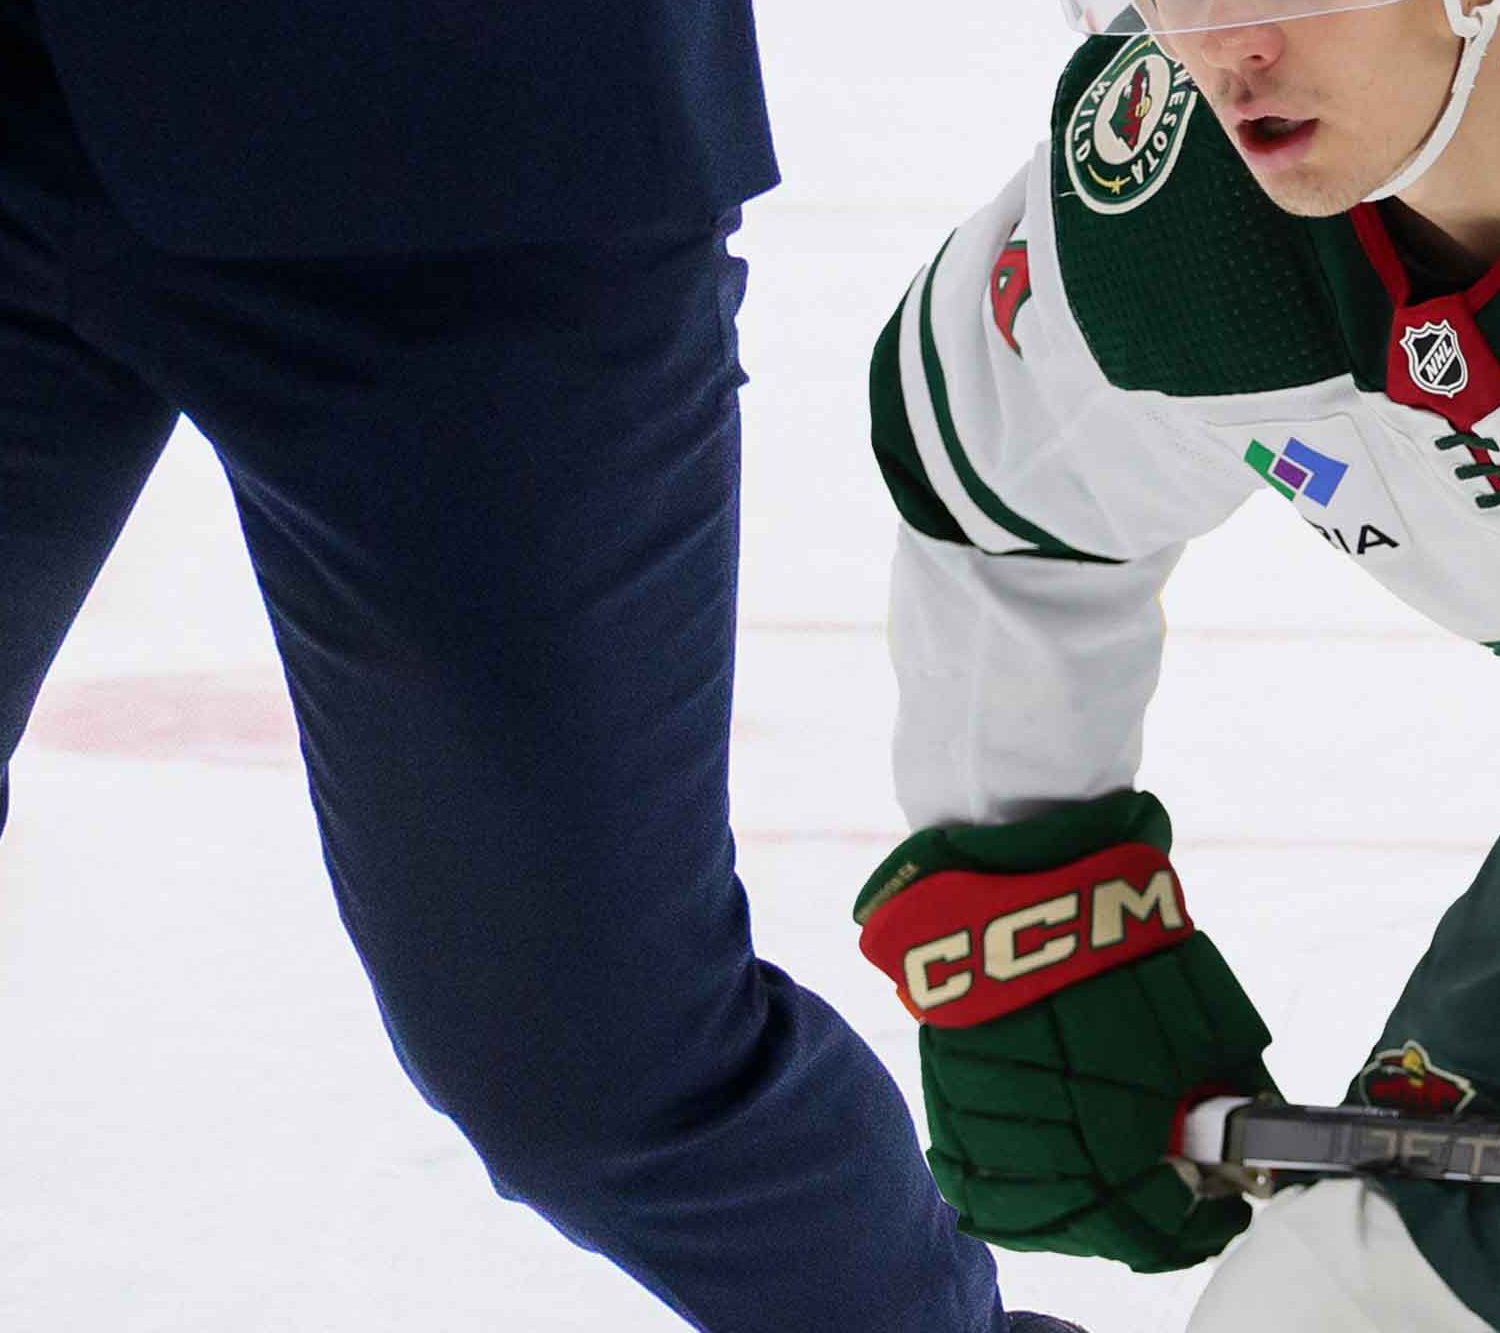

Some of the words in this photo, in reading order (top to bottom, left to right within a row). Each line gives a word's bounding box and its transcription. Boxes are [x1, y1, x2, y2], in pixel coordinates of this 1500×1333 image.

[1073, 79, 1113, 164] WILD
[1424, 336, 1455, 386] NHL
[904, 870, 1186, 1012] CCM
